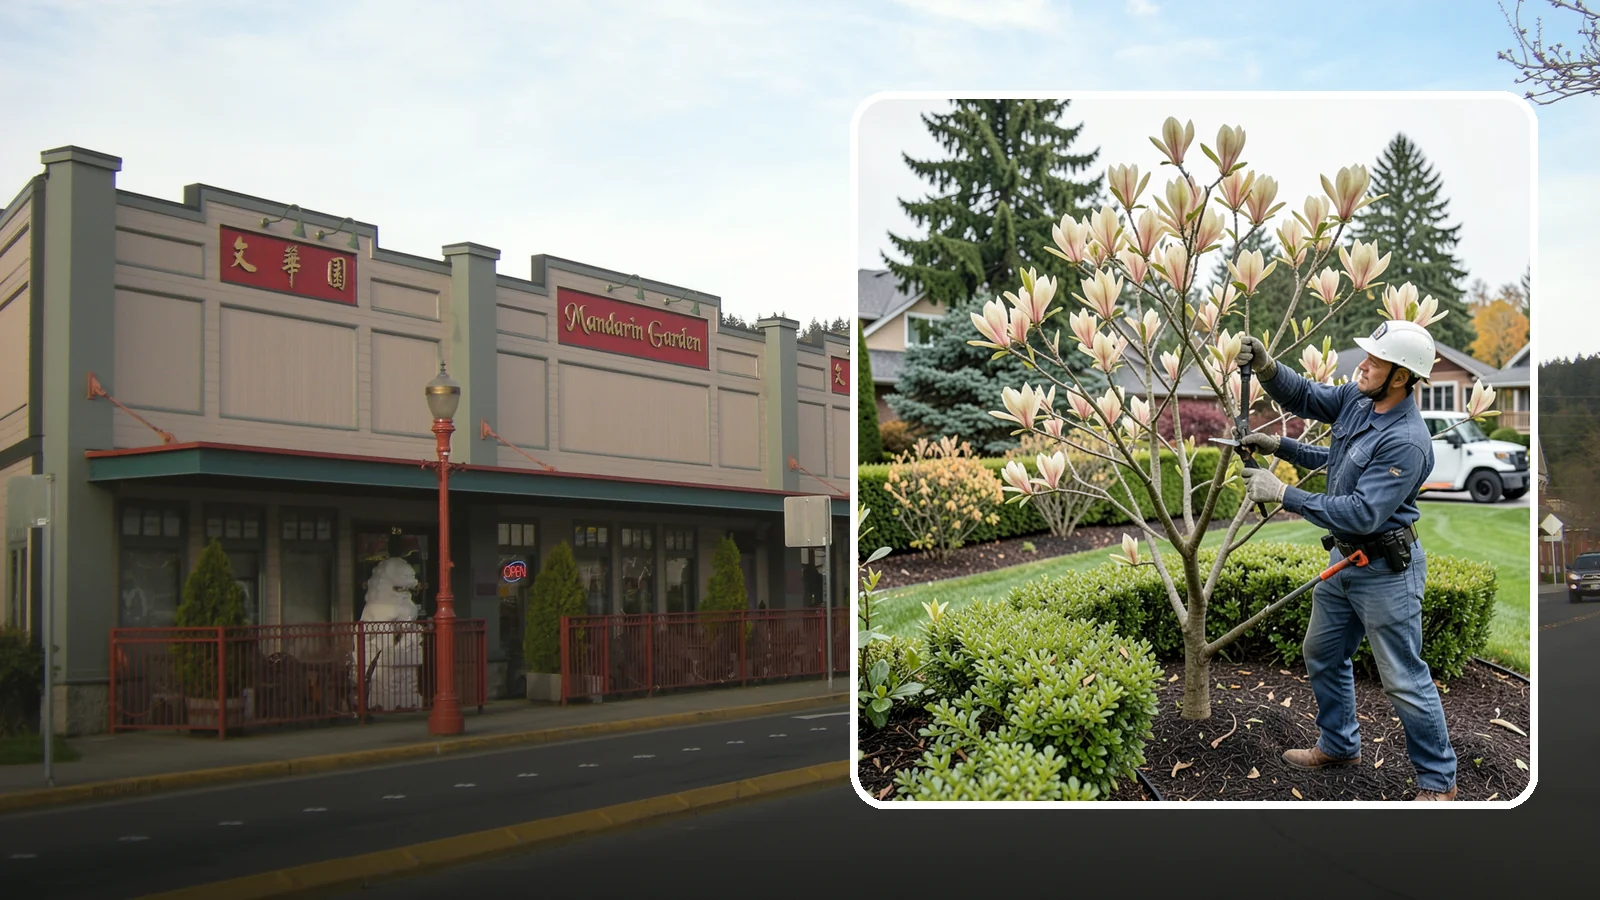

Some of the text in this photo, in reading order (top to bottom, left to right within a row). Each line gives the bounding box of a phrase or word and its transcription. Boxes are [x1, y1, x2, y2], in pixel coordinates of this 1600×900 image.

[230, 235, 346, 291] 文華園
[564, 302, 701, 352] Mandarin Garden
[503, 565, 527, 578] OPEN
